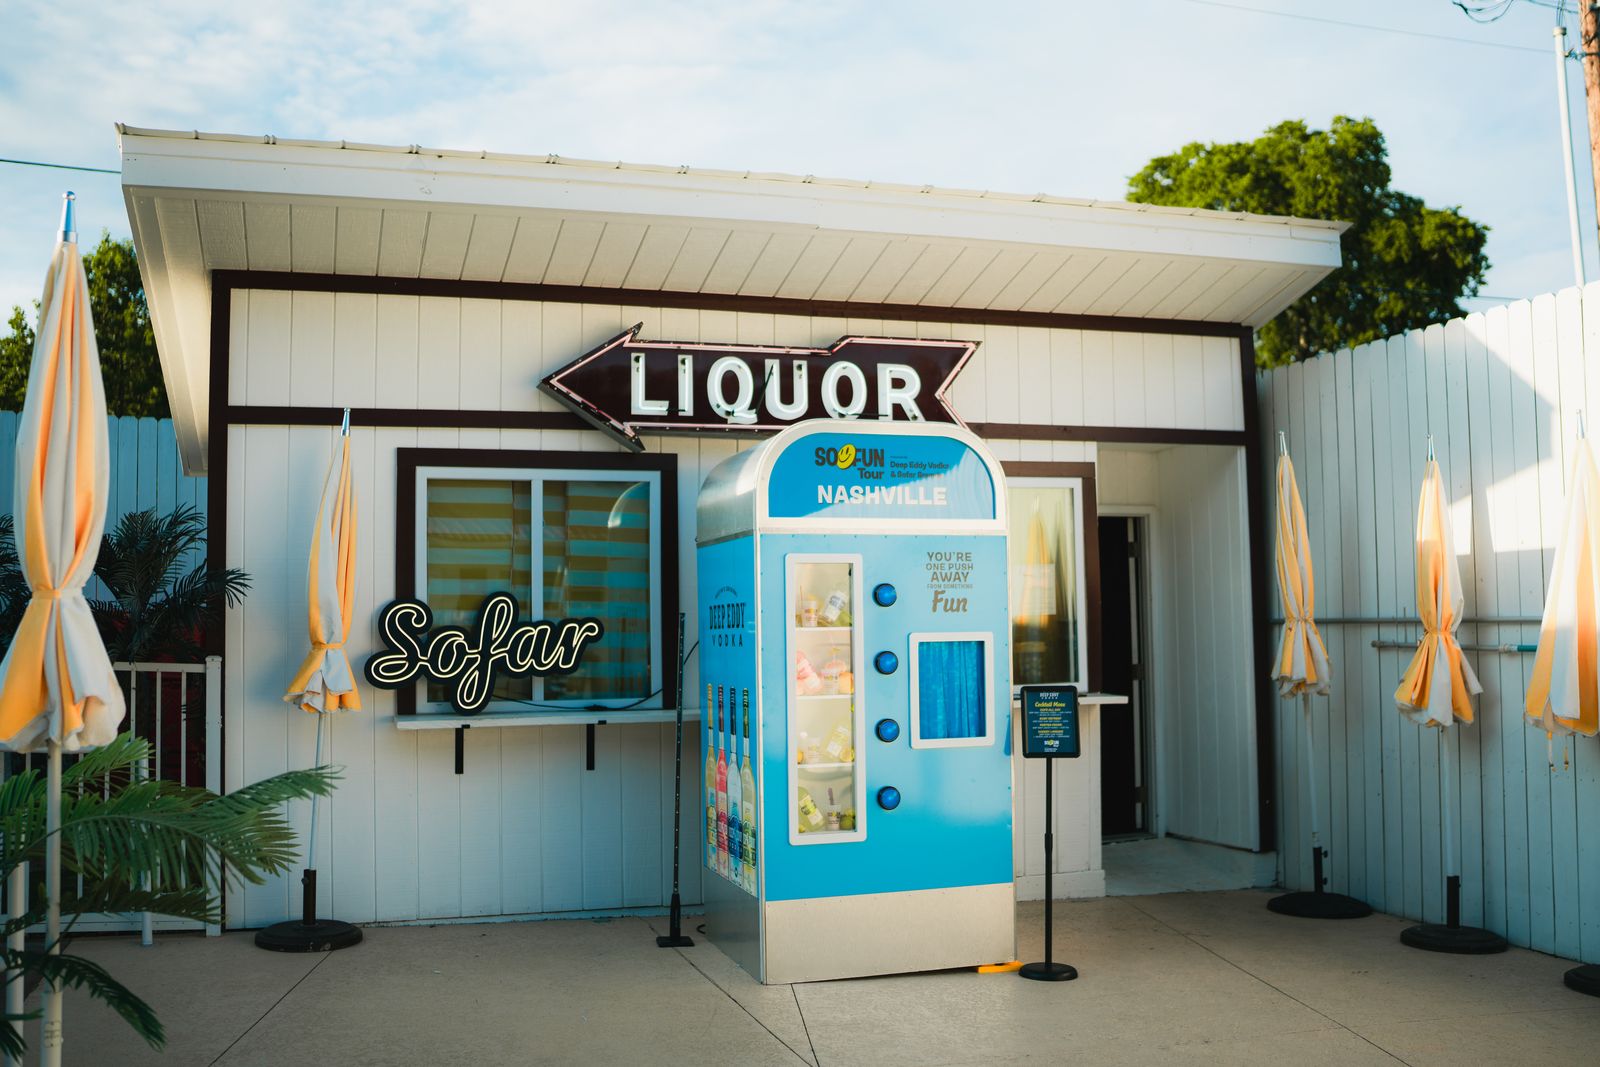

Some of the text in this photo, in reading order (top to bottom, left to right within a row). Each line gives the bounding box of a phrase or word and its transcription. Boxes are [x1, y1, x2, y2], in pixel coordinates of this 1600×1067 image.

[630, 352, 926, 424] LIQUOR
[909, 461, 927, 471] Eddy
[857, 467, 885, 480] Tour
[817, 485, 948, 506] NASHVILLE
[926, 551, 972, 562] YOU'RE
[925, 562, 974, 571] ONE PUSH
[930, 571, 970, 582] AWAY
[931, 590, 968, 613] Fun
[709, 602, 746, 630] DEEP EDDY
[711, 633, 744, 647] VODKA
[369, 595, 600, 711] Sofar
